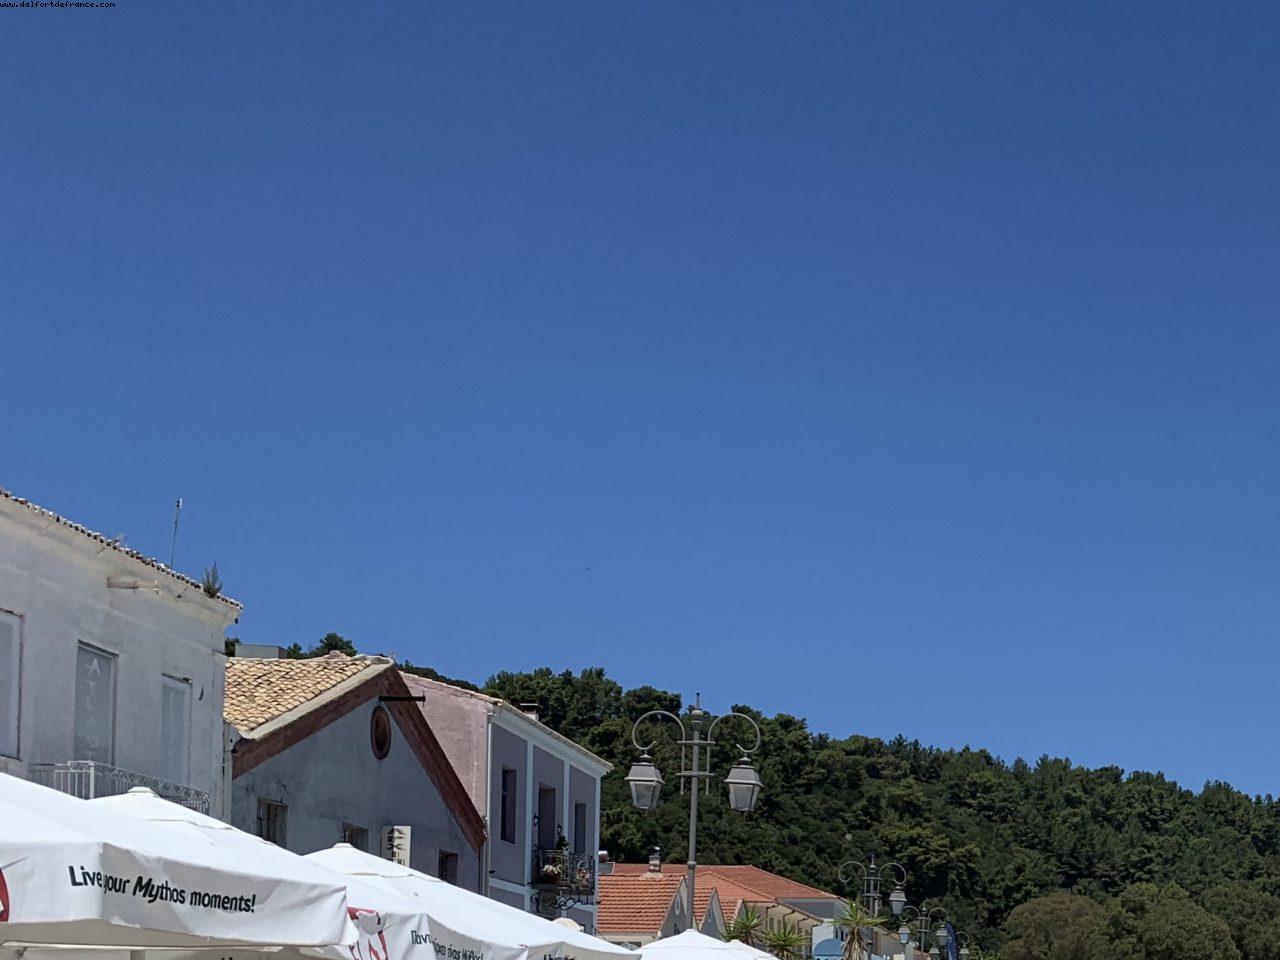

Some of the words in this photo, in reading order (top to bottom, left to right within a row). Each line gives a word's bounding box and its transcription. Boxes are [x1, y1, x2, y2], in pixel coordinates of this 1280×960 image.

[68, 865, 103, 888] Live
[132, 876, 185, 903] Mythos
[190, 891, 256, 913] moments!
